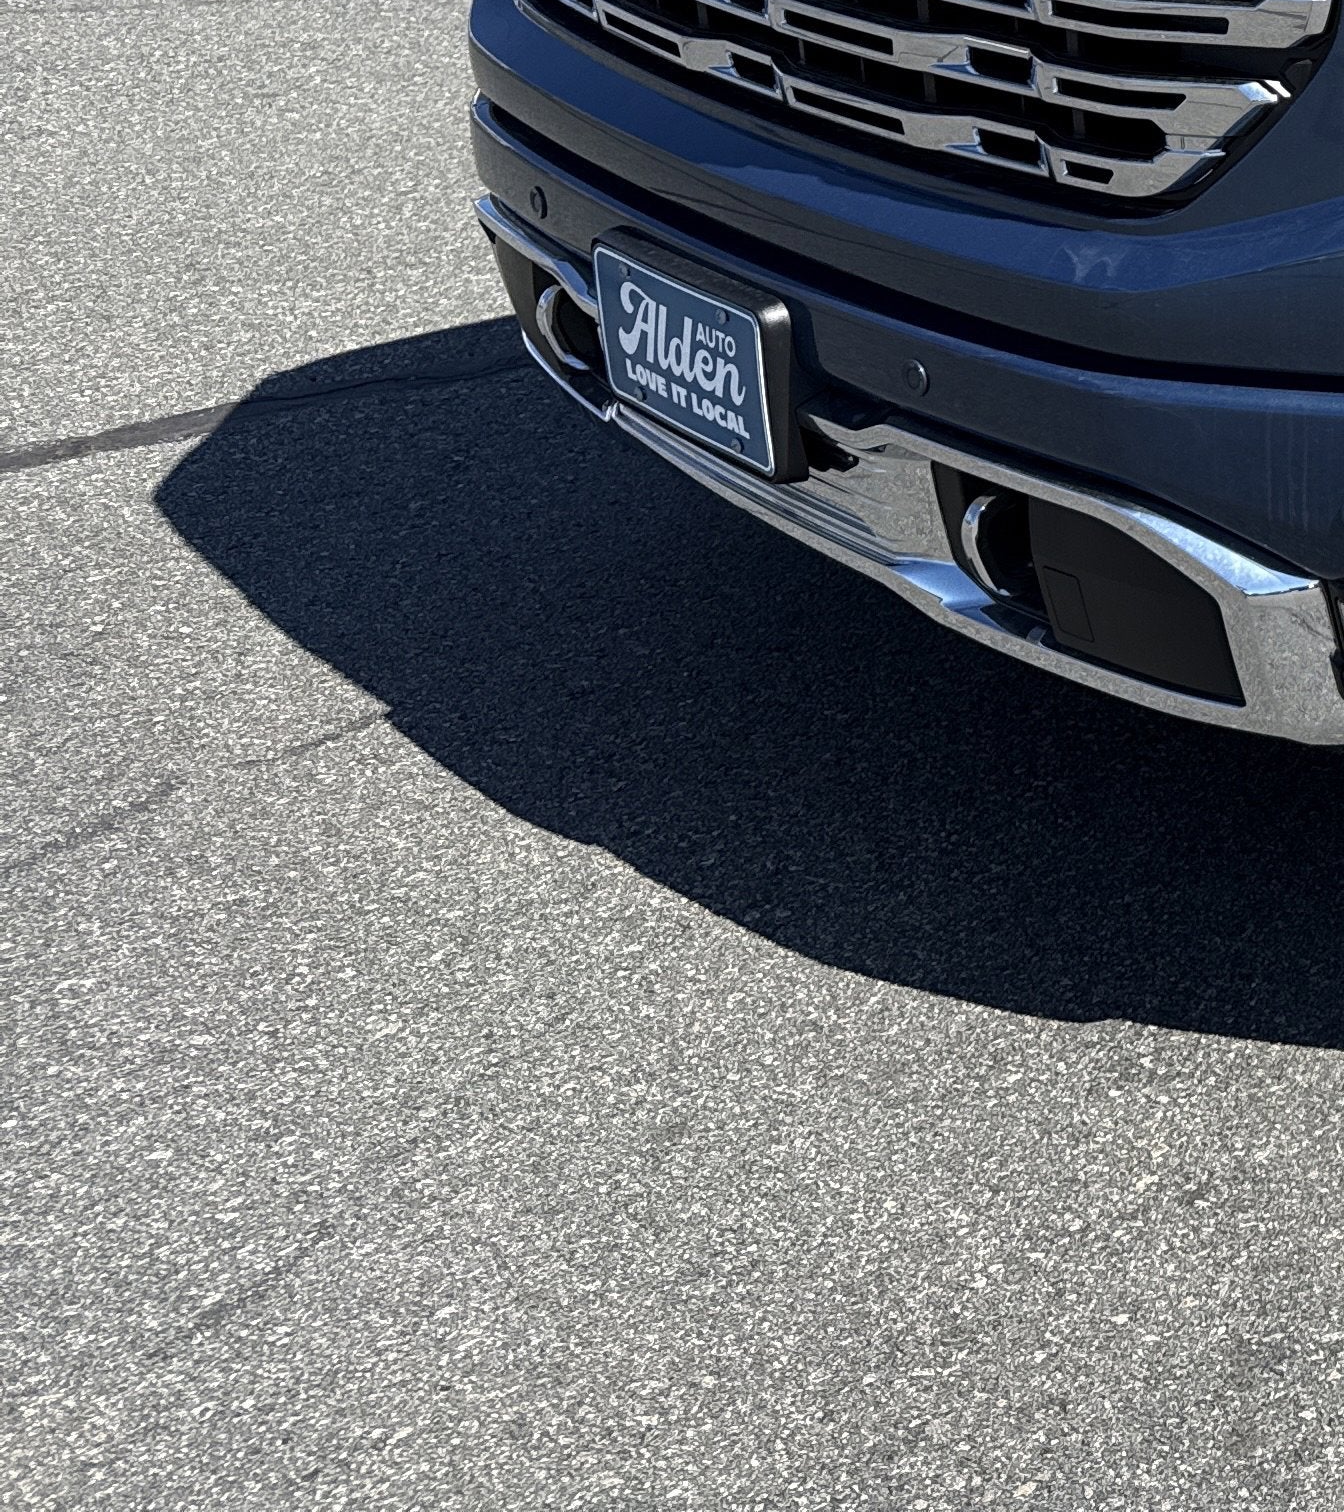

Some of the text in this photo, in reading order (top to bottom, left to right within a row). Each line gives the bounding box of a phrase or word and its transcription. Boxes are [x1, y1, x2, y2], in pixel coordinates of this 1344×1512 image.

[617, 281, 746, 407] Alden
[695, 321, 737, 358] AUTO
[625, 357, 751, 440] LOVE IT LOCAL
